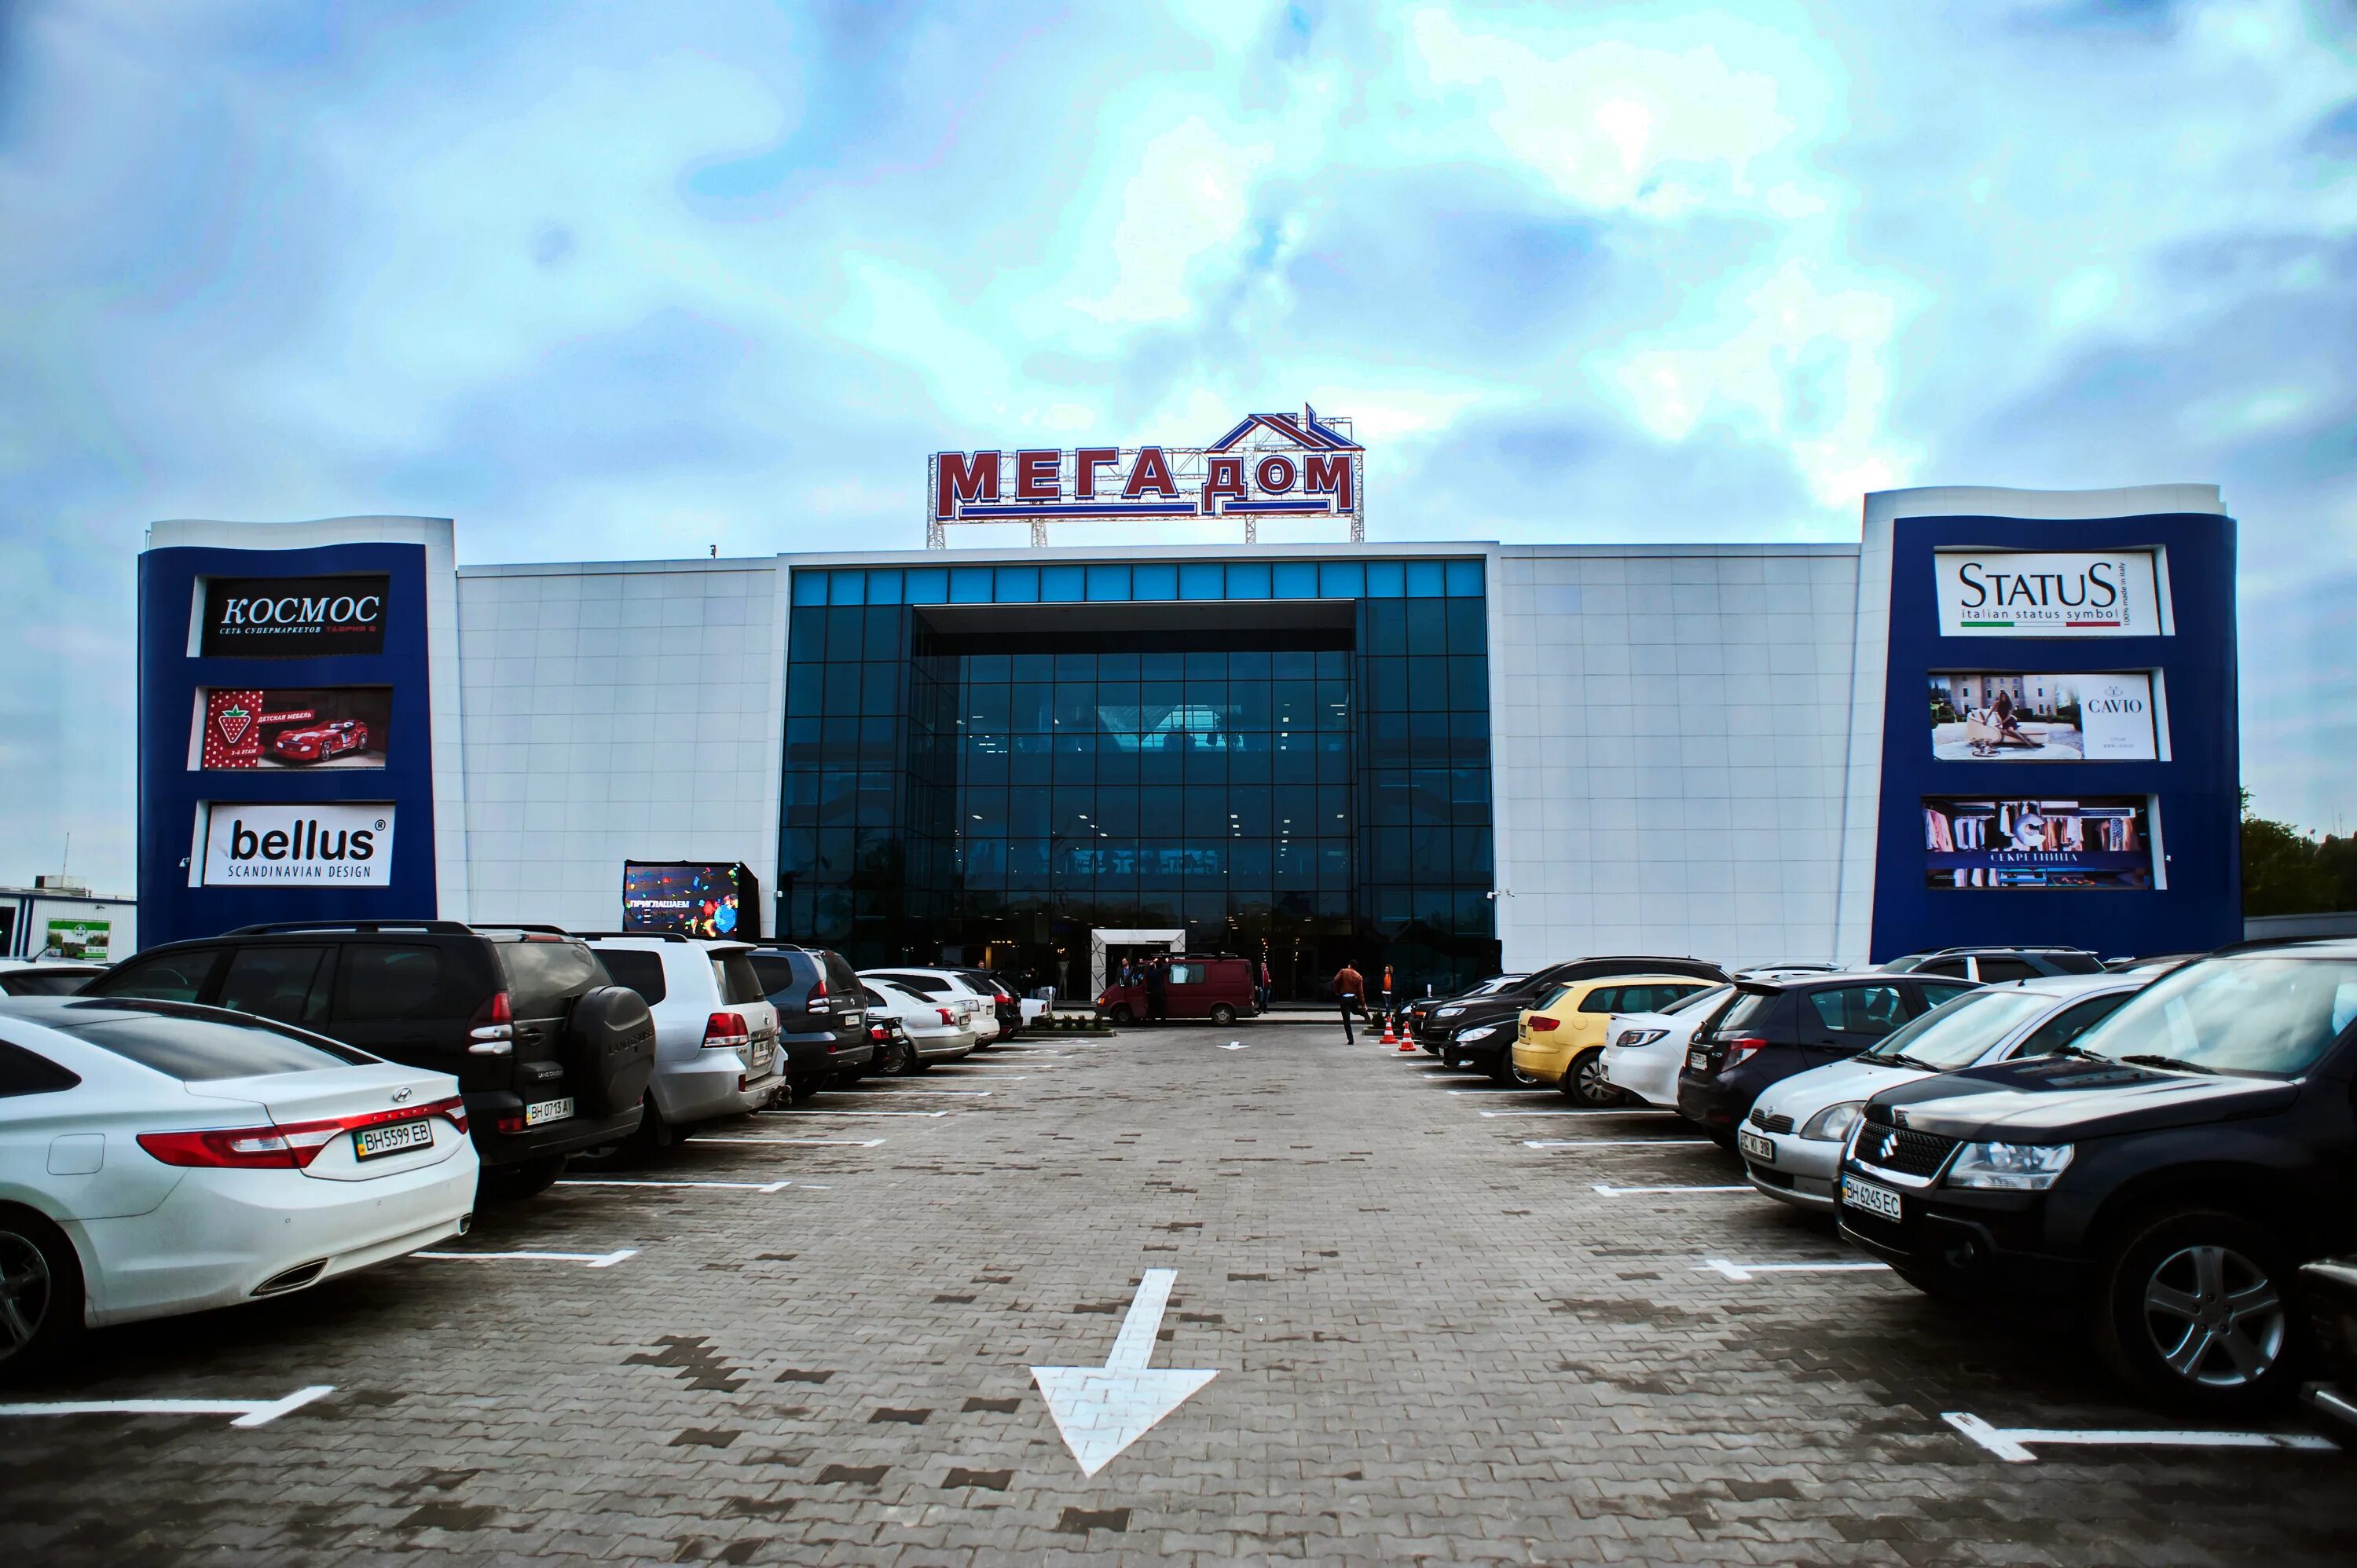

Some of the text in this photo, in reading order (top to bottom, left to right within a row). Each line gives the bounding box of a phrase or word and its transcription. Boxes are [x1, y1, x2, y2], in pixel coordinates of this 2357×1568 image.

[936, 445, 1354, 521] МЕГА ДОМ
[221, 595, 379, 624] КОСМОС
[1962, 608, 2119, 621] italian status symbol
[2088, 698, 2142, 713] CAVIO
[258, 714, 286, 723] ДЕТСКАЯ
[230, 819, 374, 860] bellus
[228, 865, 371, 877] SCANDINAVIAN DESIGN
[629, 899, 690, 908] ПРИГЛАШАЕМ
[544, 1101, 562, 1116] 0713
[1860, 1186, 1882, 1210] 6245
[1883, 1193, 1899, 1215] EC
